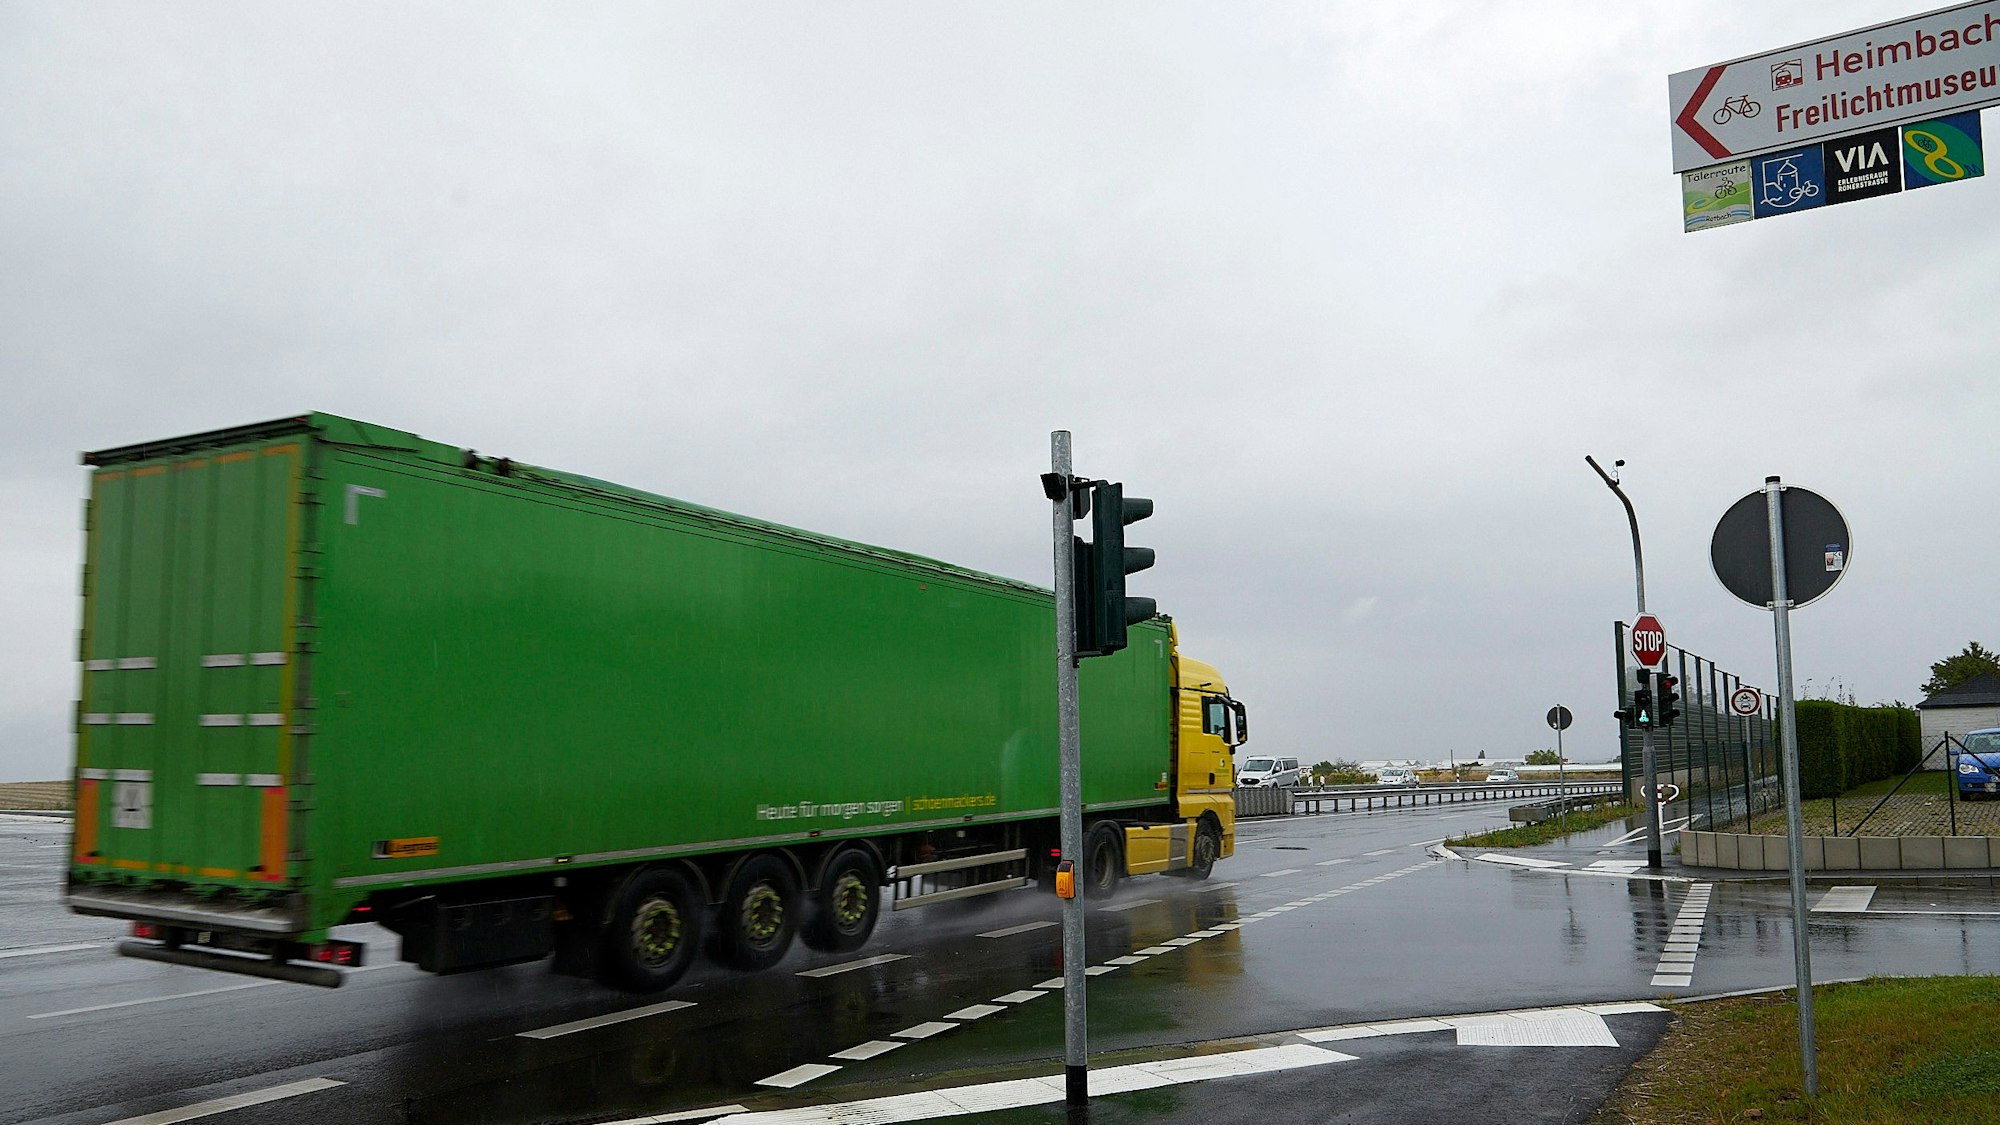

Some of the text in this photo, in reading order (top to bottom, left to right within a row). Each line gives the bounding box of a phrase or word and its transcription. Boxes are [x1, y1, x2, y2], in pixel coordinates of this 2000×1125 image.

[1816, 13, 2000, 81] Heimbach
[1776, 64, 2000, 133] Freilichtmuseu
[1834, 142, 1889, 173] VIA
[1685, 165, 1746, 183] Tälerroute
[1837, 170, 1889, 186] ERLEBNISRAUM
[1634, 630, 1663, 652] STOP
[757, 804, 797, 820] Heute
[799, 801, 820, 818] für
[820, 803, 865, 819] morgen
[866, 800, 904, 817] sorgen
